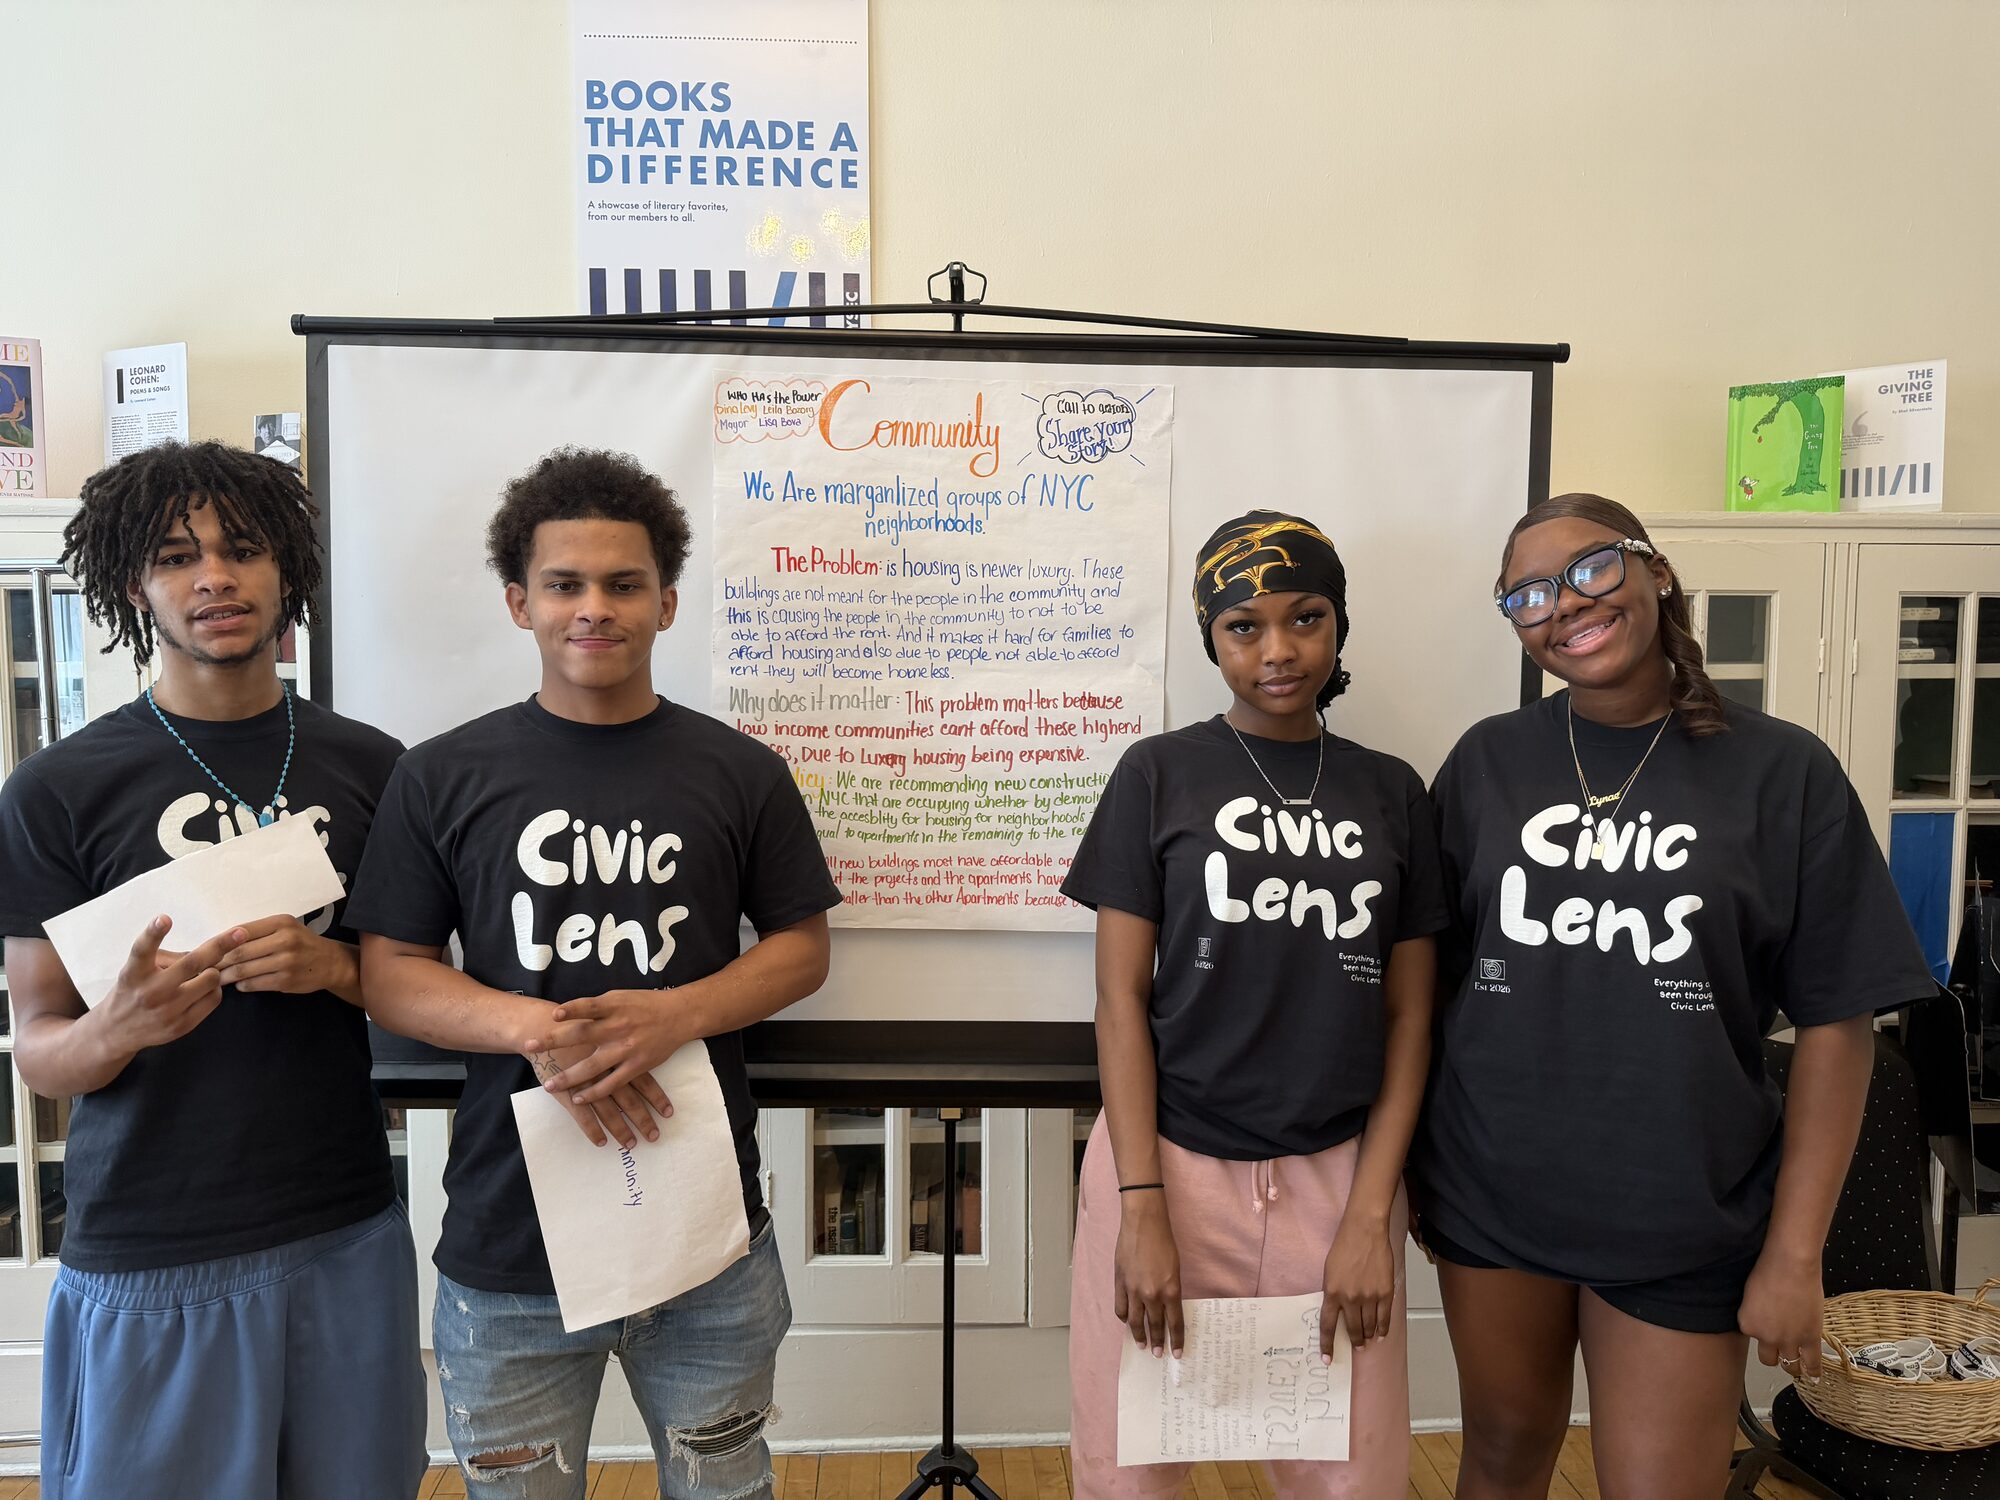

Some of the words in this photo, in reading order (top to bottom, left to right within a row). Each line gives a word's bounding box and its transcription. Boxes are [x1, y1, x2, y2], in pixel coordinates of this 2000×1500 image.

[585, 79, 732, 113] BOOKS
[584, 116, 685, 148] THAT
[698, 119, 815, 152] MADE
[829, 121, 859, 152] A
[587, 153, 859, 189] DIFFERENCE
[587, 200, 595, 209] A
[597, 200, 640, 210] showcase
[642, 201, 652, 210] of
[654, 201, 686, 212] literary
[688, 201, 729, 212] favorites,
[587, 211, 608, 221] from
[628, 212, 668, 222] members
[670, 214, 679, 222] to
[681, 213, 695, 222] all.
[129, 364, 166, 376] LEONARD
[129, 374, 160, 386] COHEN:
[1908, 368, 1933, 380] THE
[130, 387, 147, 395] POEMS
[153, 385, 170, 393] SONGS
[774, 391, 790, 404] the
[791, 390, 822, 404] Power
[1878, 380, 1933, 395] GIVING
[1057, 399, 1079, 415] Call
[1082, 400, 1095, 415] to
[1901, 392, 1932, 404] TREE
[720, 419, 749, 434] Mayor
[819, 379, 1000, 478] Community
[1045, 418, 1094, 450] Share
[743, 470, 774, 501] We
[782, 470, 817, 502] Are
[946, 490, 1002, 521] groups
[1007, 473, 1036, 506] of
[1040, 473, 1094, 512] NYC
[865, 510, 986, 546] neighborhoods.
[770, 546, 809, 573] The
[811, 546, 882, 576] Problem:
[886, 561, 897, 576] is
[903, 548, 961, 586] housing
[965, 562, 978, 578] is
[981, 562, 1024, 579] newer
[1028, 558, 1075, 586] luxury.
[1083, 558, 1125, 580] These
[724, 575, 780, 607] buildings
[782, 589, 801, 602] are
[804, 585, 825, 602] not
[828, 589, 864, 604] meant
[868, 589, 888, 606] for
[891, 589, 913, 606] the
[915, 593, 959, 611] people
[963, 592, 977, 604] in
[980, 584, 1004, 604] the
[1009, 584, 1086, 606] community
[1090, 581, 1122, 599] and
[726, 607, 752, 625] this
[757, 607, 769, 625] is
[772, 608, 820, 628] causing
[823, 607, 843, 624] the
[846, 610, 881, 629] people
[886, 610, 901, 624] in
[904, 610, 926, 626] the
[930, 609, 1005, 626] community
[1009, 606, 1025, 619] to
[1028, 603, 1055, 618] not
[1060, 603, 1077, 616] to
[1084, 601, 1104, 615] be
[731, 629, 760, 642] able
[766, 628, 781, 642] to
[785, 629, 829, 642] afford
[832, 627, 856, 640] the
[860, 626, 891, 640] rent.
[896, 625, 921, 643] And
[926, 627, 935, 643] it
[939, 630, 984, 645] makes
[988, 629, 999, 644] it
[1004, 627, 1034, 646] hard
[1037, 627, 1058, 642] for
[1062, 624, 1112, 642] families
[1119, 624, 1134, 639] to
[730, 664, 758, 676] rent
[763, 664, 795, 684] they
[802, 664, 827, 678] will
[832, 664, 884, 681] become
[729, 686, 765, 722] Why
[768, 689, 807, 713] does
[811, 684, 825, 712] it
[829, 686, 900, 712] matter:
[904, 690, 934, 715] This
[940, 692, 998, 719] problem
[1003, 689, 1058, 713] matters
[774, 720, 830, 739] income
[834, 720, 934, 739] communities
[940, 720, 976, 737] cant
[979, 716, 1029, 738] afford
[1034, 716, 1078, 737] these
[1083, 715, 1142, 743] highend
[839, 859, 865, 870] new
[868, 852, 920, 872] buildings
[923, 856, 953, 868] most
[957, 855, 987, 867] have
[990, 852, 1053, 867] affordable
[1204, 850, 1383, 941] Lens
[1499, 865, 1704, 966] Lens
[511, 890, 690, 976] Lens
[1338, 952, 1375, 966] Everything
[1350, 973, 1366, 983] Civic
[1360, 965, 1382, 977] throug
[1654, 978, 1704, 991] Everything
[1659, 990, 1682, 999] seen
[1684, 991, 1713, 1002] throug
[1670, 1001, 1694, 1011] Civic
[1696, 1003, 1715, 1012] Lens
